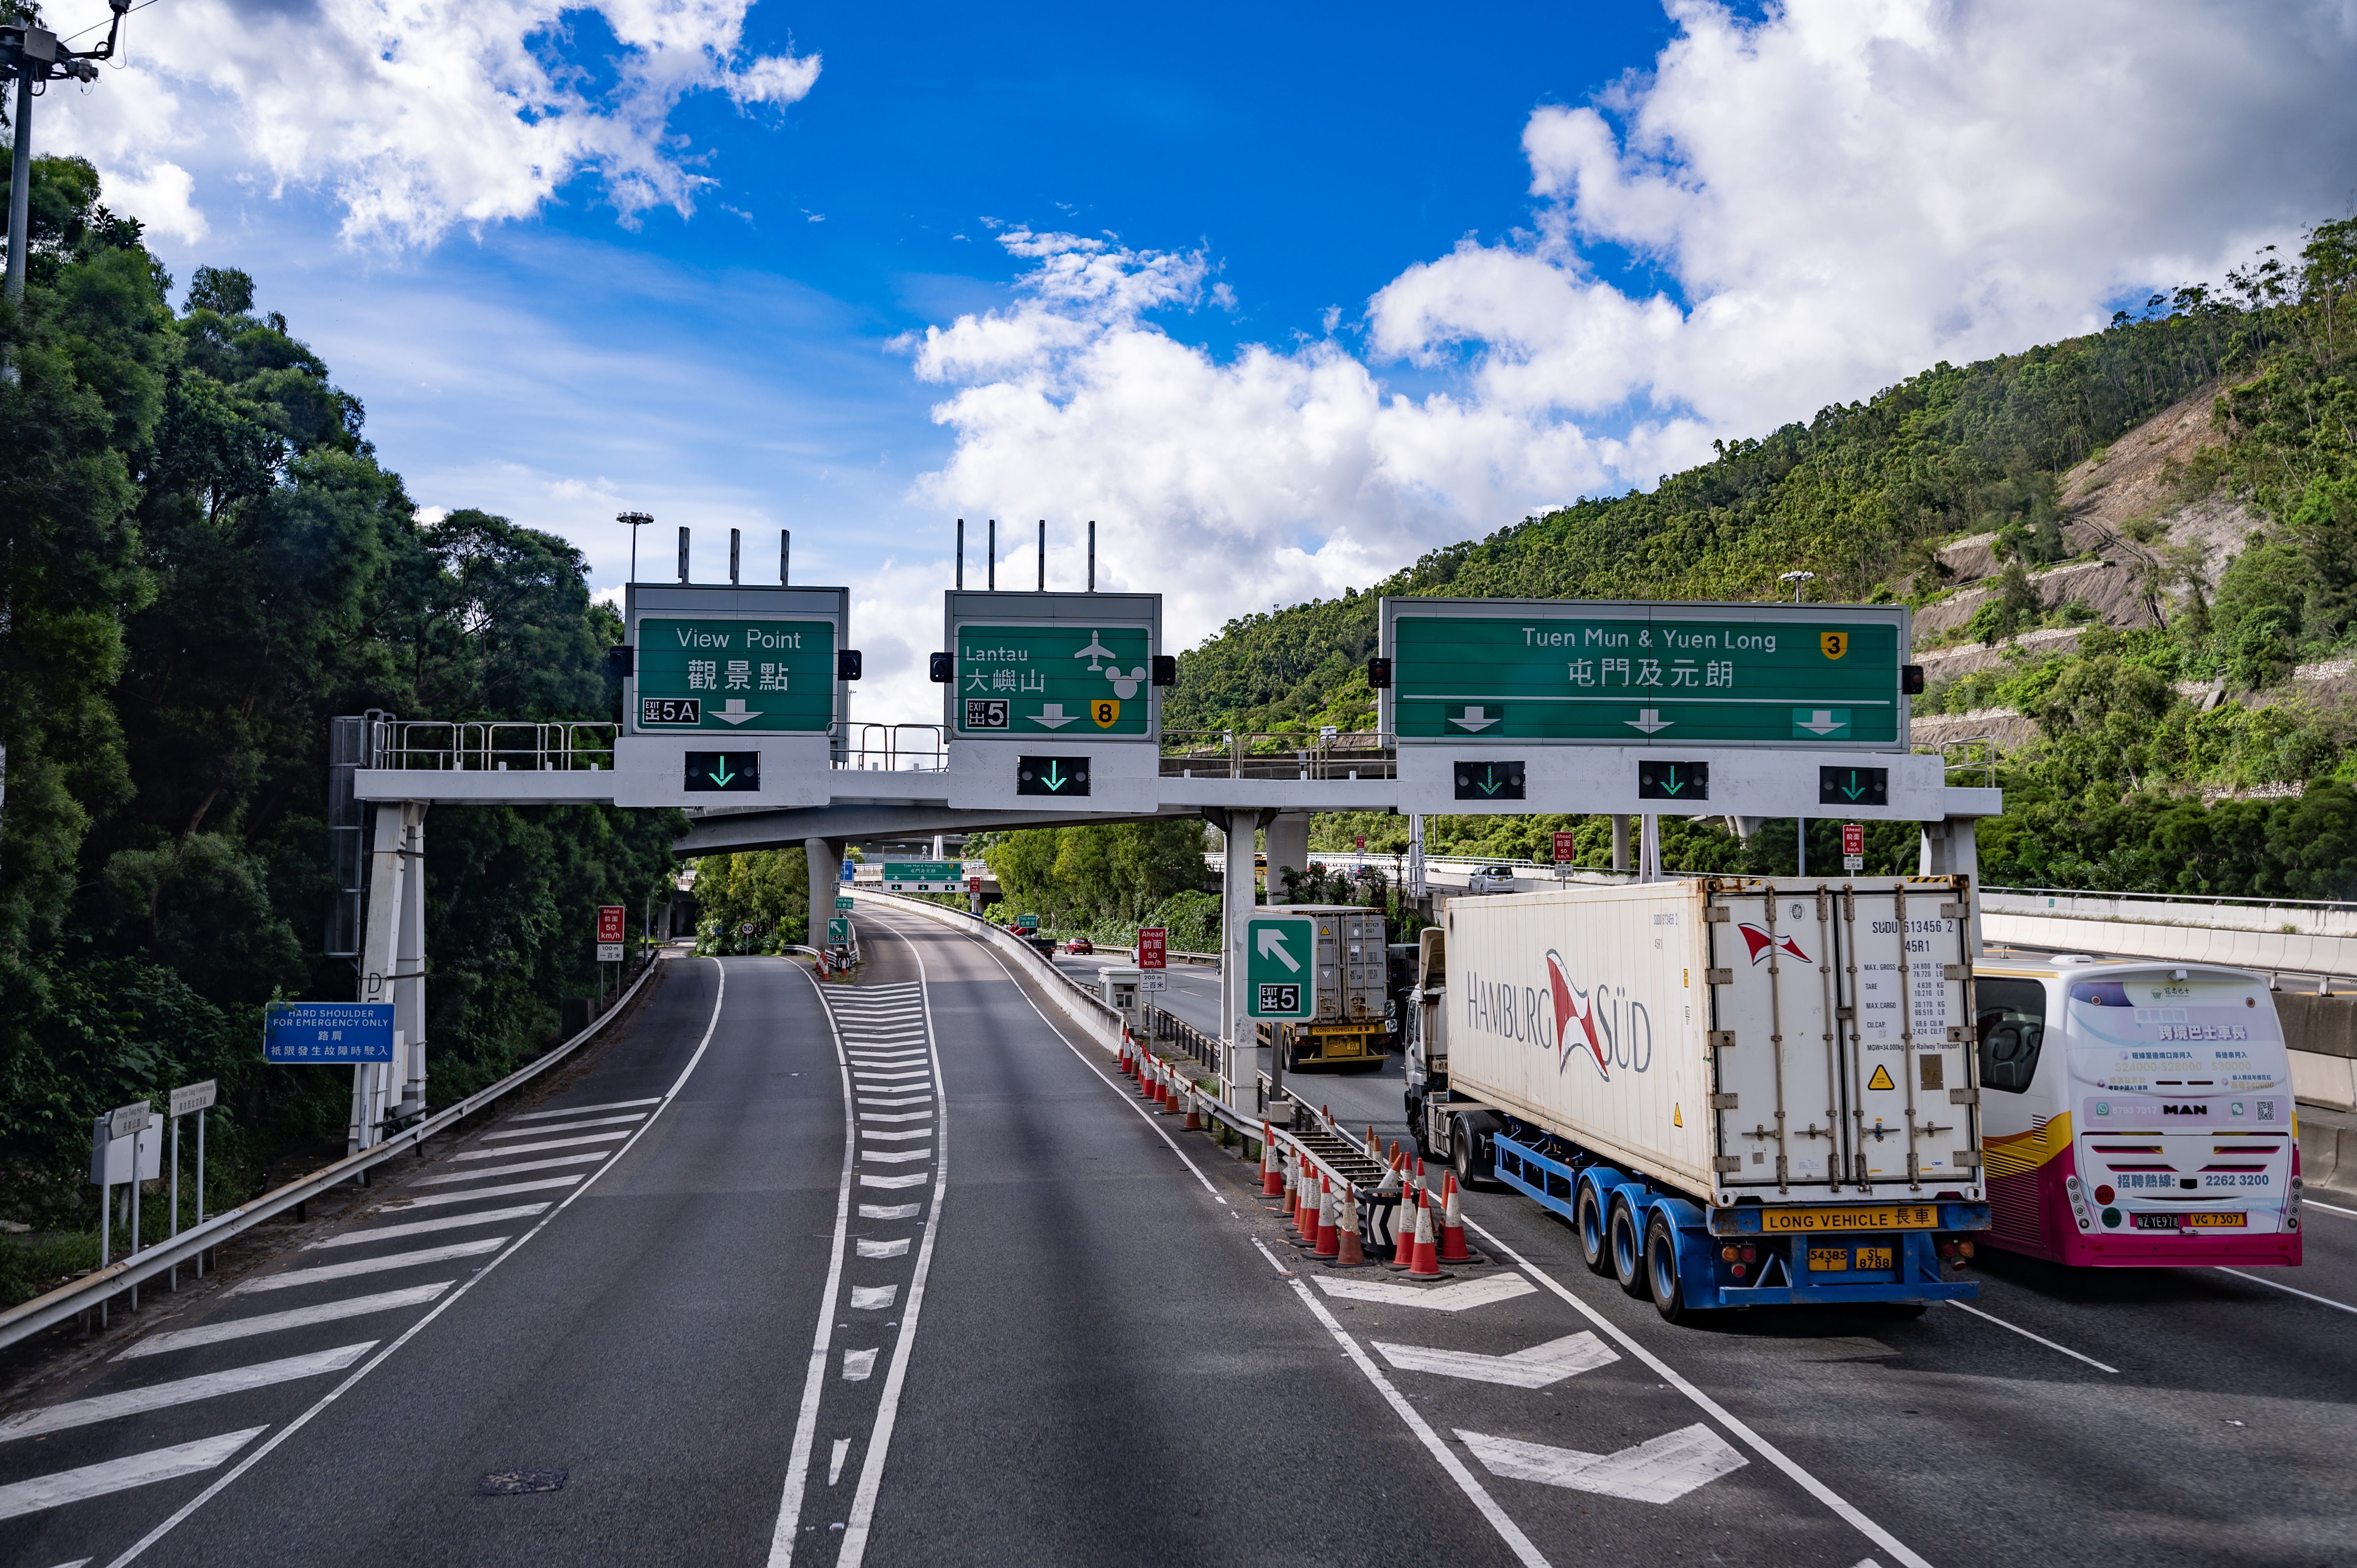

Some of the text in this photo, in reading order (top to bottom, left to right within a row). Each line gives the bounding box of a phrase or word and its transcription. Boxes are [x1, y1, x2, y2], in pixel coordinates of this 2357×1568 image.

[677, 628, 801, 649] View Point
[1523, 628, 1776, 653] Tuen Mun & Yuen Long
[1827, 636, 1840, 654] 3
[966, 646, 1028, 661] Lantau
[688, 660, 788, 690] 觀景點
[965, 669, 1044, 692] 大嶼山
[1567, 658, 1733, 688] 屯門及元朗
[663, 702, 694, 720] 5A
[969, 703, 985, 711] EXIT
[988, 703, 1004, 725] 5
[1099, 703, 1112, 723] 8
[1873, 920, 1953, 933] SUDU 613456 2
[1143, 940, 1162, 949] 前面
[1905, 940, 1929, 952] 45R1
[1262, 987, 1277, 996] EXIT
[1281, 988, 1295, 1008] 5
[1467, 971, 1552, 1049] HAMBURG
[318, 1031, 342, 1041] 路肩
[1597, 984, 1651, 1073] SÜD
[2158, 1025, 2246, 1040] 跨境巴士車長
[2211, 1061, 2251, 1071] $30000
[2163, 1105, 2207, 1114] MAN
[2117, 1174, 2269, 1188] 招聘熱線: 2262 3200
[1770, 1208, 1930, 1228] LONG VEHICLE 長車
[2194, 1215, 2239, 1224] VG 7307
[1810, 1250, 1847, 1260] 54385
[1867, 1249, 1882, 1259] SL
[1825, 1260, 1831, 1270] T
[1859, 1258, 1890, 1268] 8788
